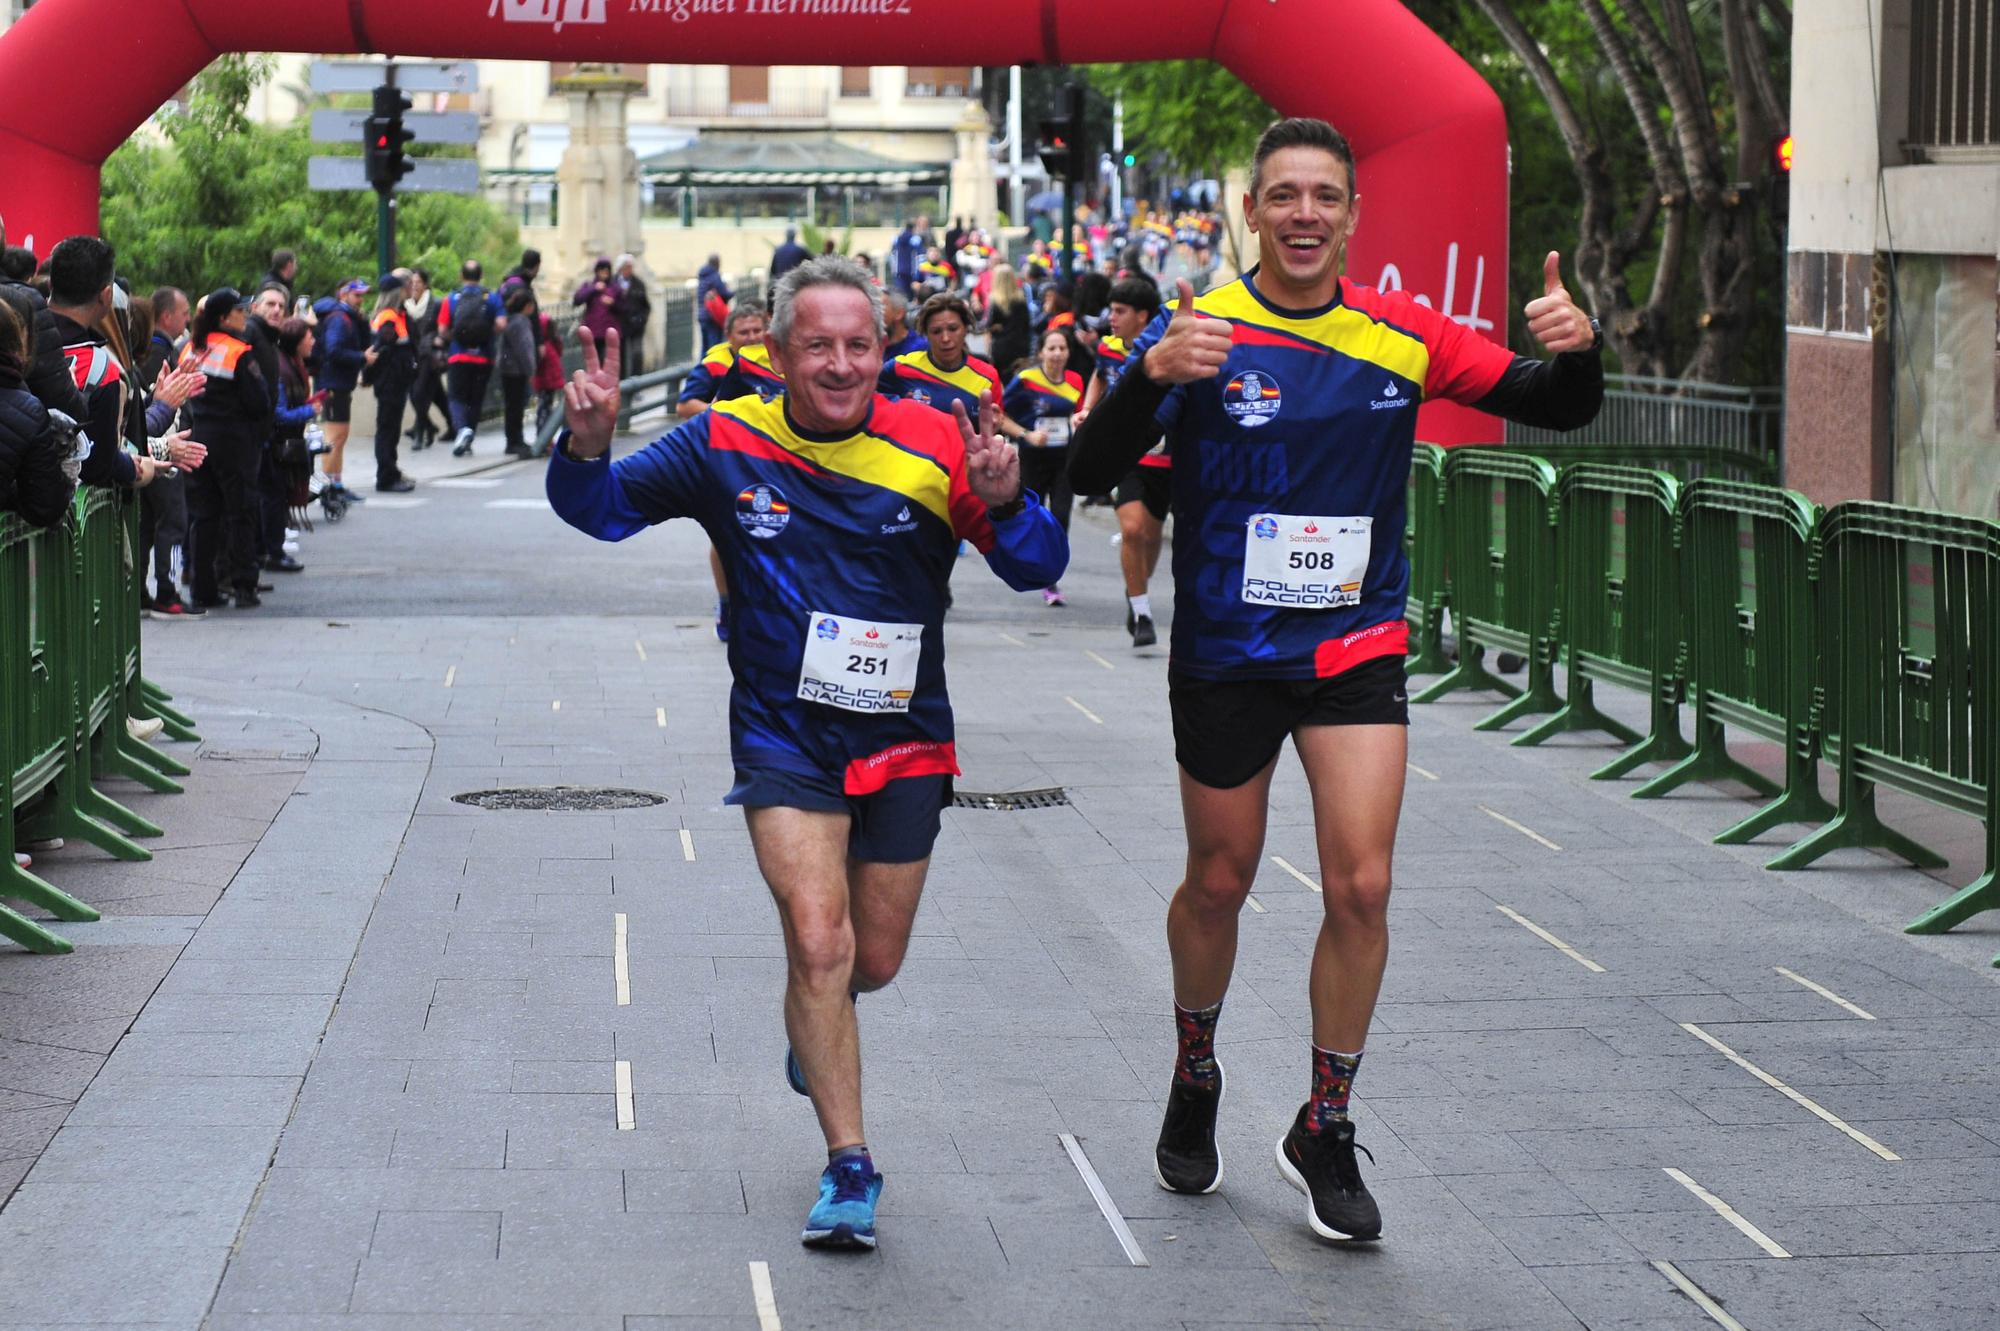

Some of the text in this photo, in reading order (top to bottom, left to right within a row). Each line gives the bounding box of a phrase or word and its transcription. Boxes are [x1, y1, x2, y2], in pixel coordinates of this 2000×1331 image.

[1371, 398, 1411, 410] Santander
[1289, 535, 1332, 544] Santander
[1289, 551, 1335, 570] 508
[1247, 578, 1343, 594] POLICIA
[1245, 589, 1358, 604] NACIONAL
[849, 637, 889, 649] Santander
[846, 655, 889, 676] 251
[803, 677, 893, 699] POLICIA
[801, 686, 907, 709] NACIONAL
